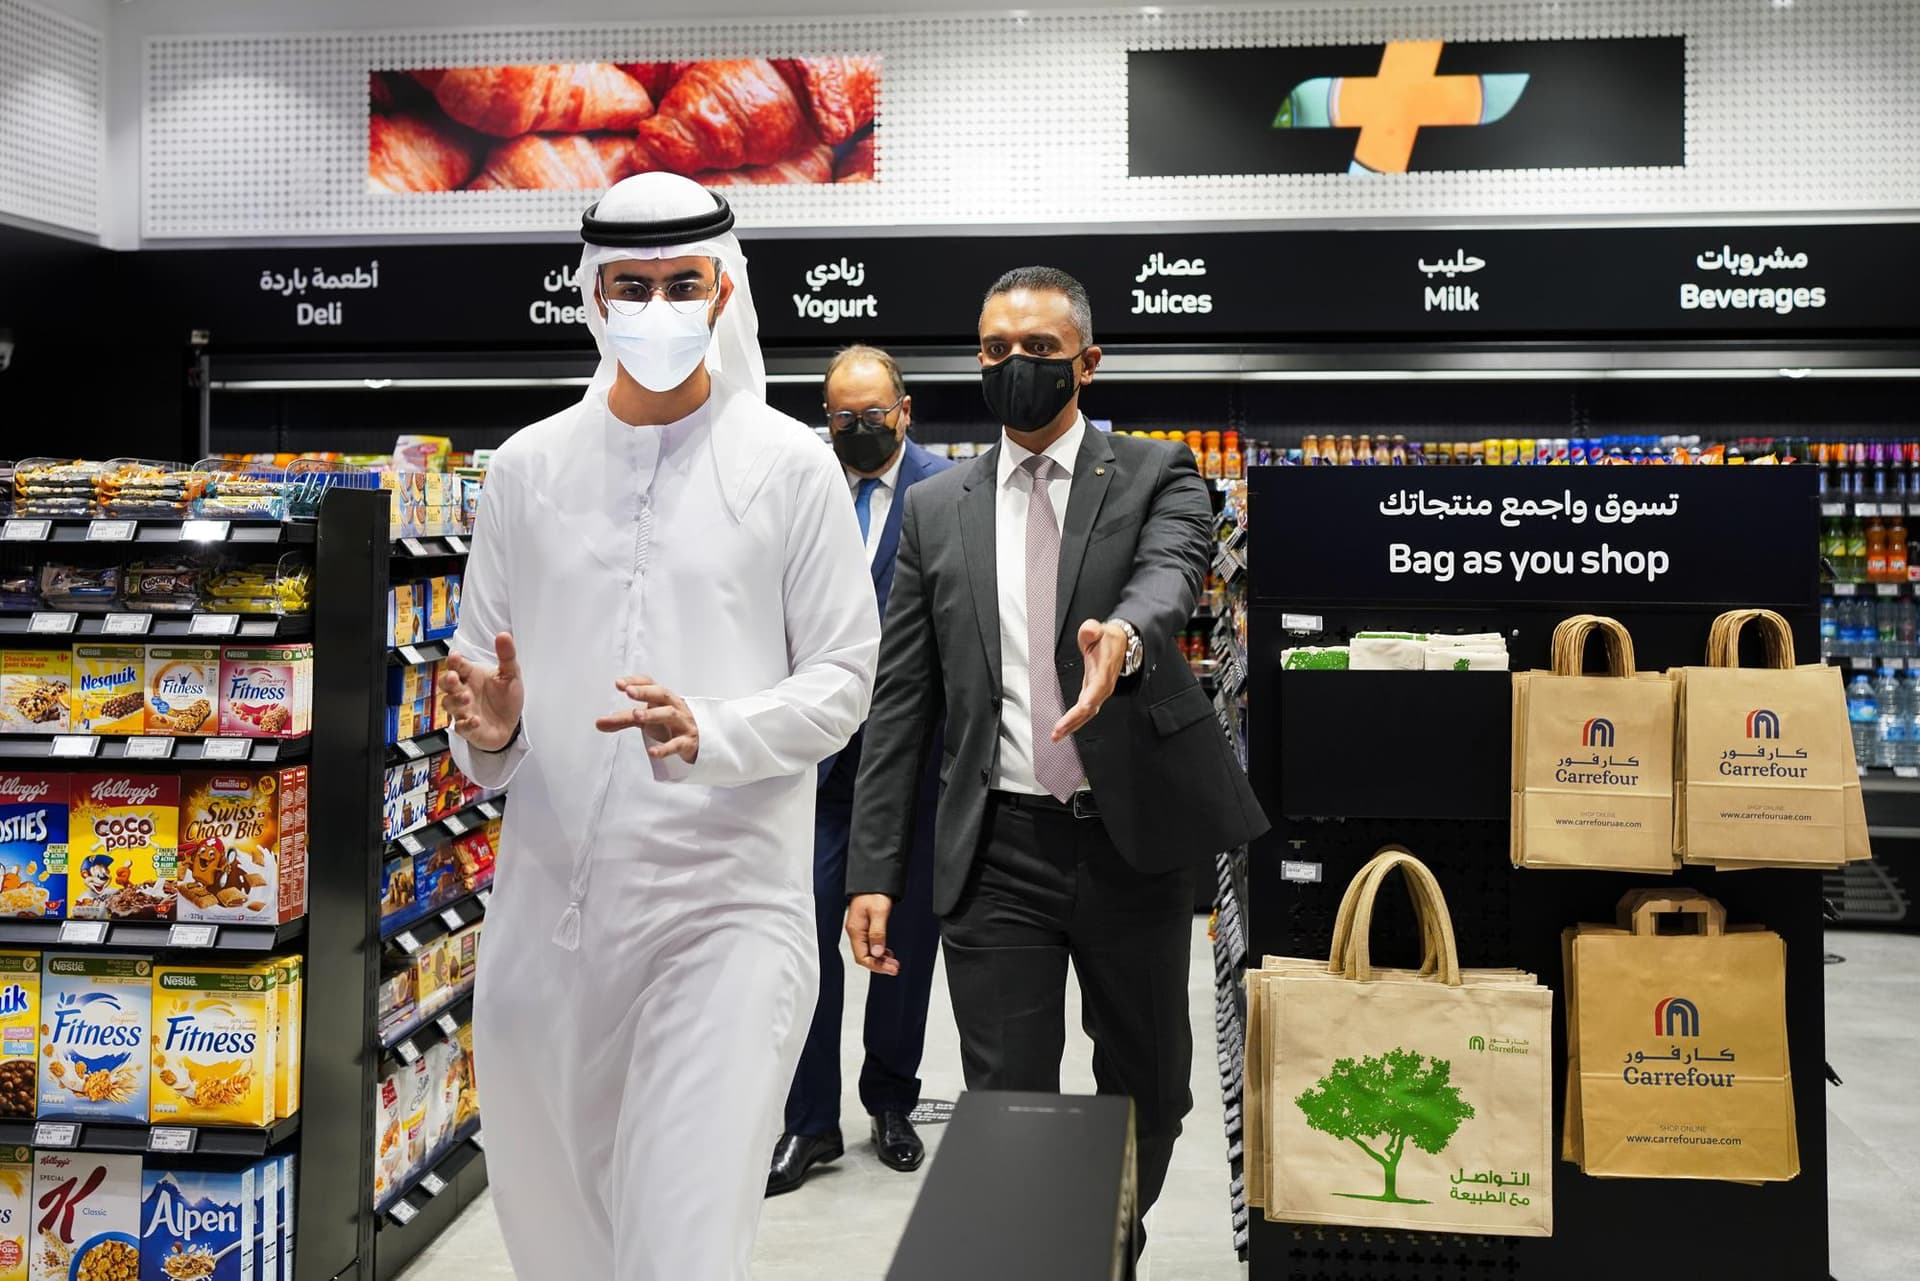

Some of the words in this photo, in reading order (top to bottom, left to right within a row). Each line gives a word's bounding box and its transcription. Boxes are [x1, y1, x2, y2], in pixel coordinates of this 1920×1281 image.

[1136, 253, 1207, 282] عصائر
[1418, 249, 1486, 278] حليب
[1697, 245, 1808, 276] مشروبات
[260, 267, 307, 296] باردة
[311, 260, 378, 289] أطعمة
[805, 257, 865, 291] زبادي
[793, 294, 877, 324] Yogurt
[1131, 289, 1213, 314] Juices
[1424, 286, 1480, 312] Milk
[1680, 284, 1826, 314] Beverages
[297, 302, 342, 325] Deli
[530, 300, 587, 324] Chee
[1379, 489, 1493, 520] منتجاتك
[1500, 489, 1588, 527] واجمع
[1595, 493, 1679, 523] تسوق
[1389, 543, 1454, 582] Bag
[1463, 550, 1502, 574] as
[1509, 550, 1574, 582] you
[1581, 543, 1669, 582] shop
[80, 666, 136, 691] Nesquik
[162, 679, 203, 694] Fitness
[230, 677, 286, 700] Fitness
[1555, 768, 1640, 786] Carrefour
[1719, 761, 1808, 779] Carrefour
[91, 778, 159, 804] Kellogg's
[205, 802, 257, 825] Swiss
[1555, 818, 1642, 828] www.carrefouruae.com
[1720, 811, 1812, 821] www.carrefouruae.com
[95, 817, 153, 837] COCO
[186, 820, 232, 841] Choco
[235, 820, 264, 839] Bits
[106, 835, 147, 851] pops
[52, 1008, 142, 1046] Fitness
[165, 1016, 257, 1054] Fitness
[1488, 1044, 1529, 1055] Carrefour
[1623, 1066, 1735, 1088] Carrefour
[1626, 1134, 1742, 1146] www.carrefouruae.com
[1450, 1168, 1530, 1187] التواصل
[38, 1165, 107, 1244] K
[1450, 1187, 1506, 1205] الطبيعة
[1509, 1193, 1530, 1206] مع
[82, 1207, 107, 1216] Classic
[143, 1191, 237, 1241] Alpen
